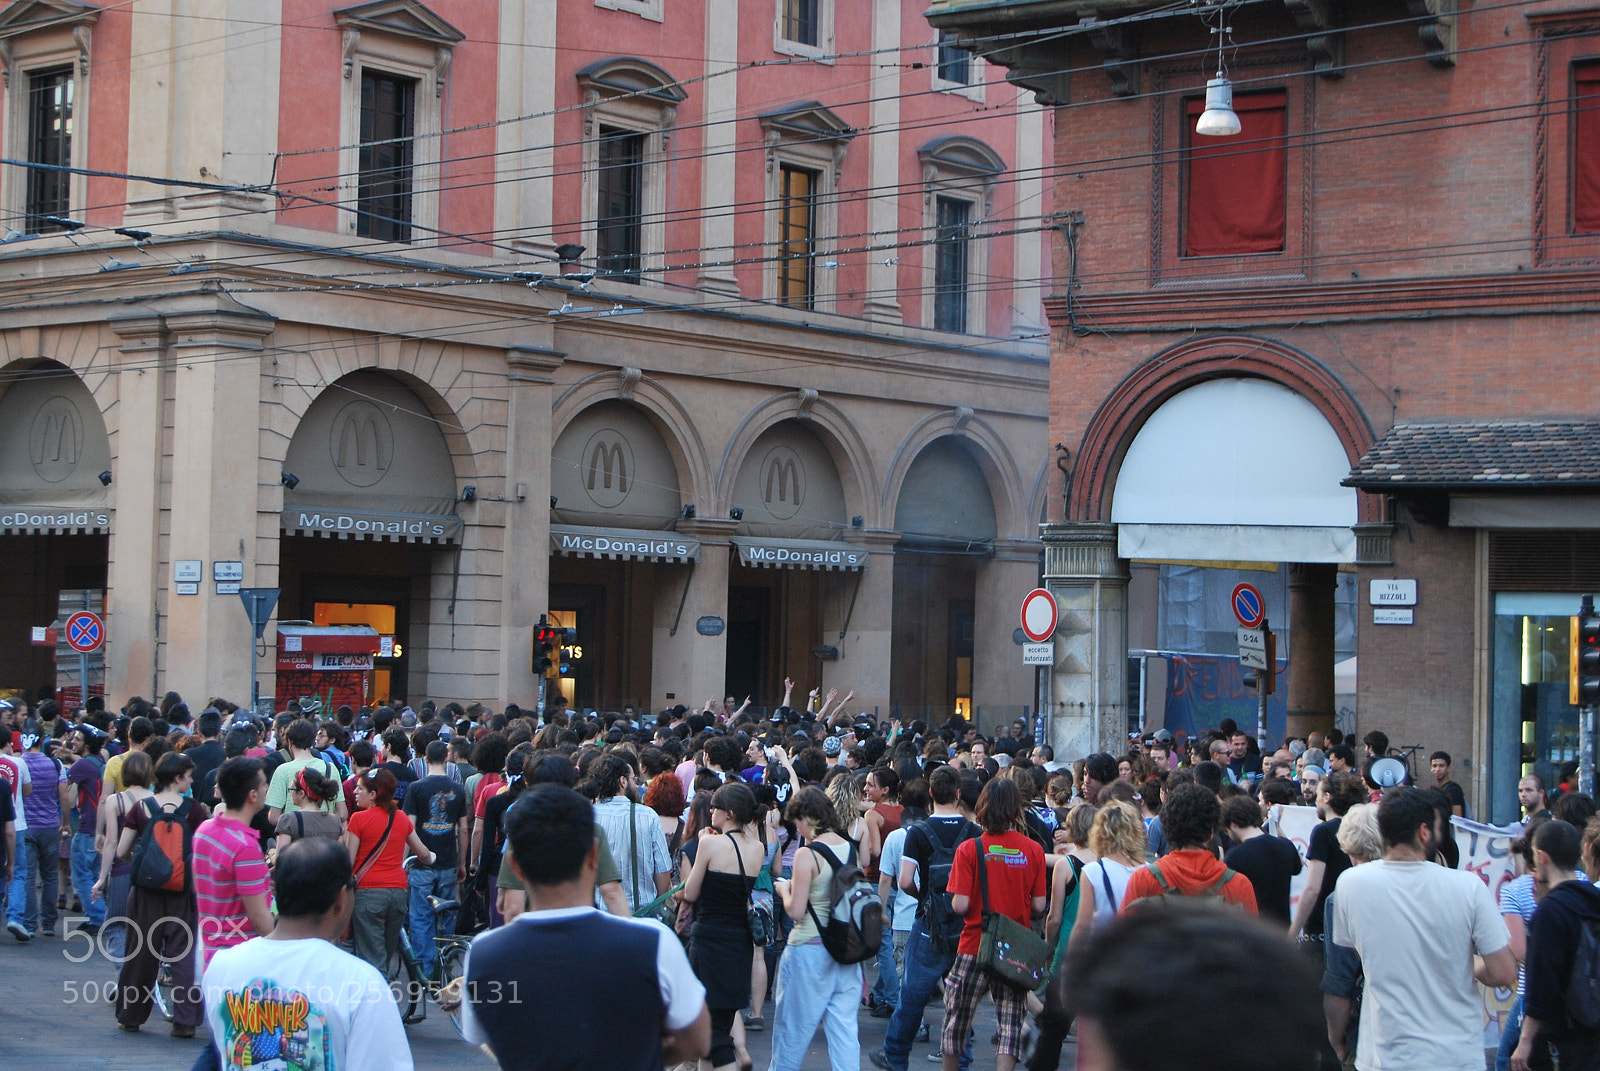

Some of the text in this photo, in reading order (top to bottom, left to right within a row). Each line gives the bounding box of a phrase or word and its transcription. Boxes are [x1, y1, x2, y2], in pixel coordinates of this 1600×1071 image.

[0, 511, 108, 526] cDonald's
[299, 513, 444, 536] McDonald's
[562, 535, 687, 555] McDonald's
[749, 547, 857, 564] McDonald's
[1243, 634, 1258, 643] 0-24
[320, 653, 371, 667] TELECASA
